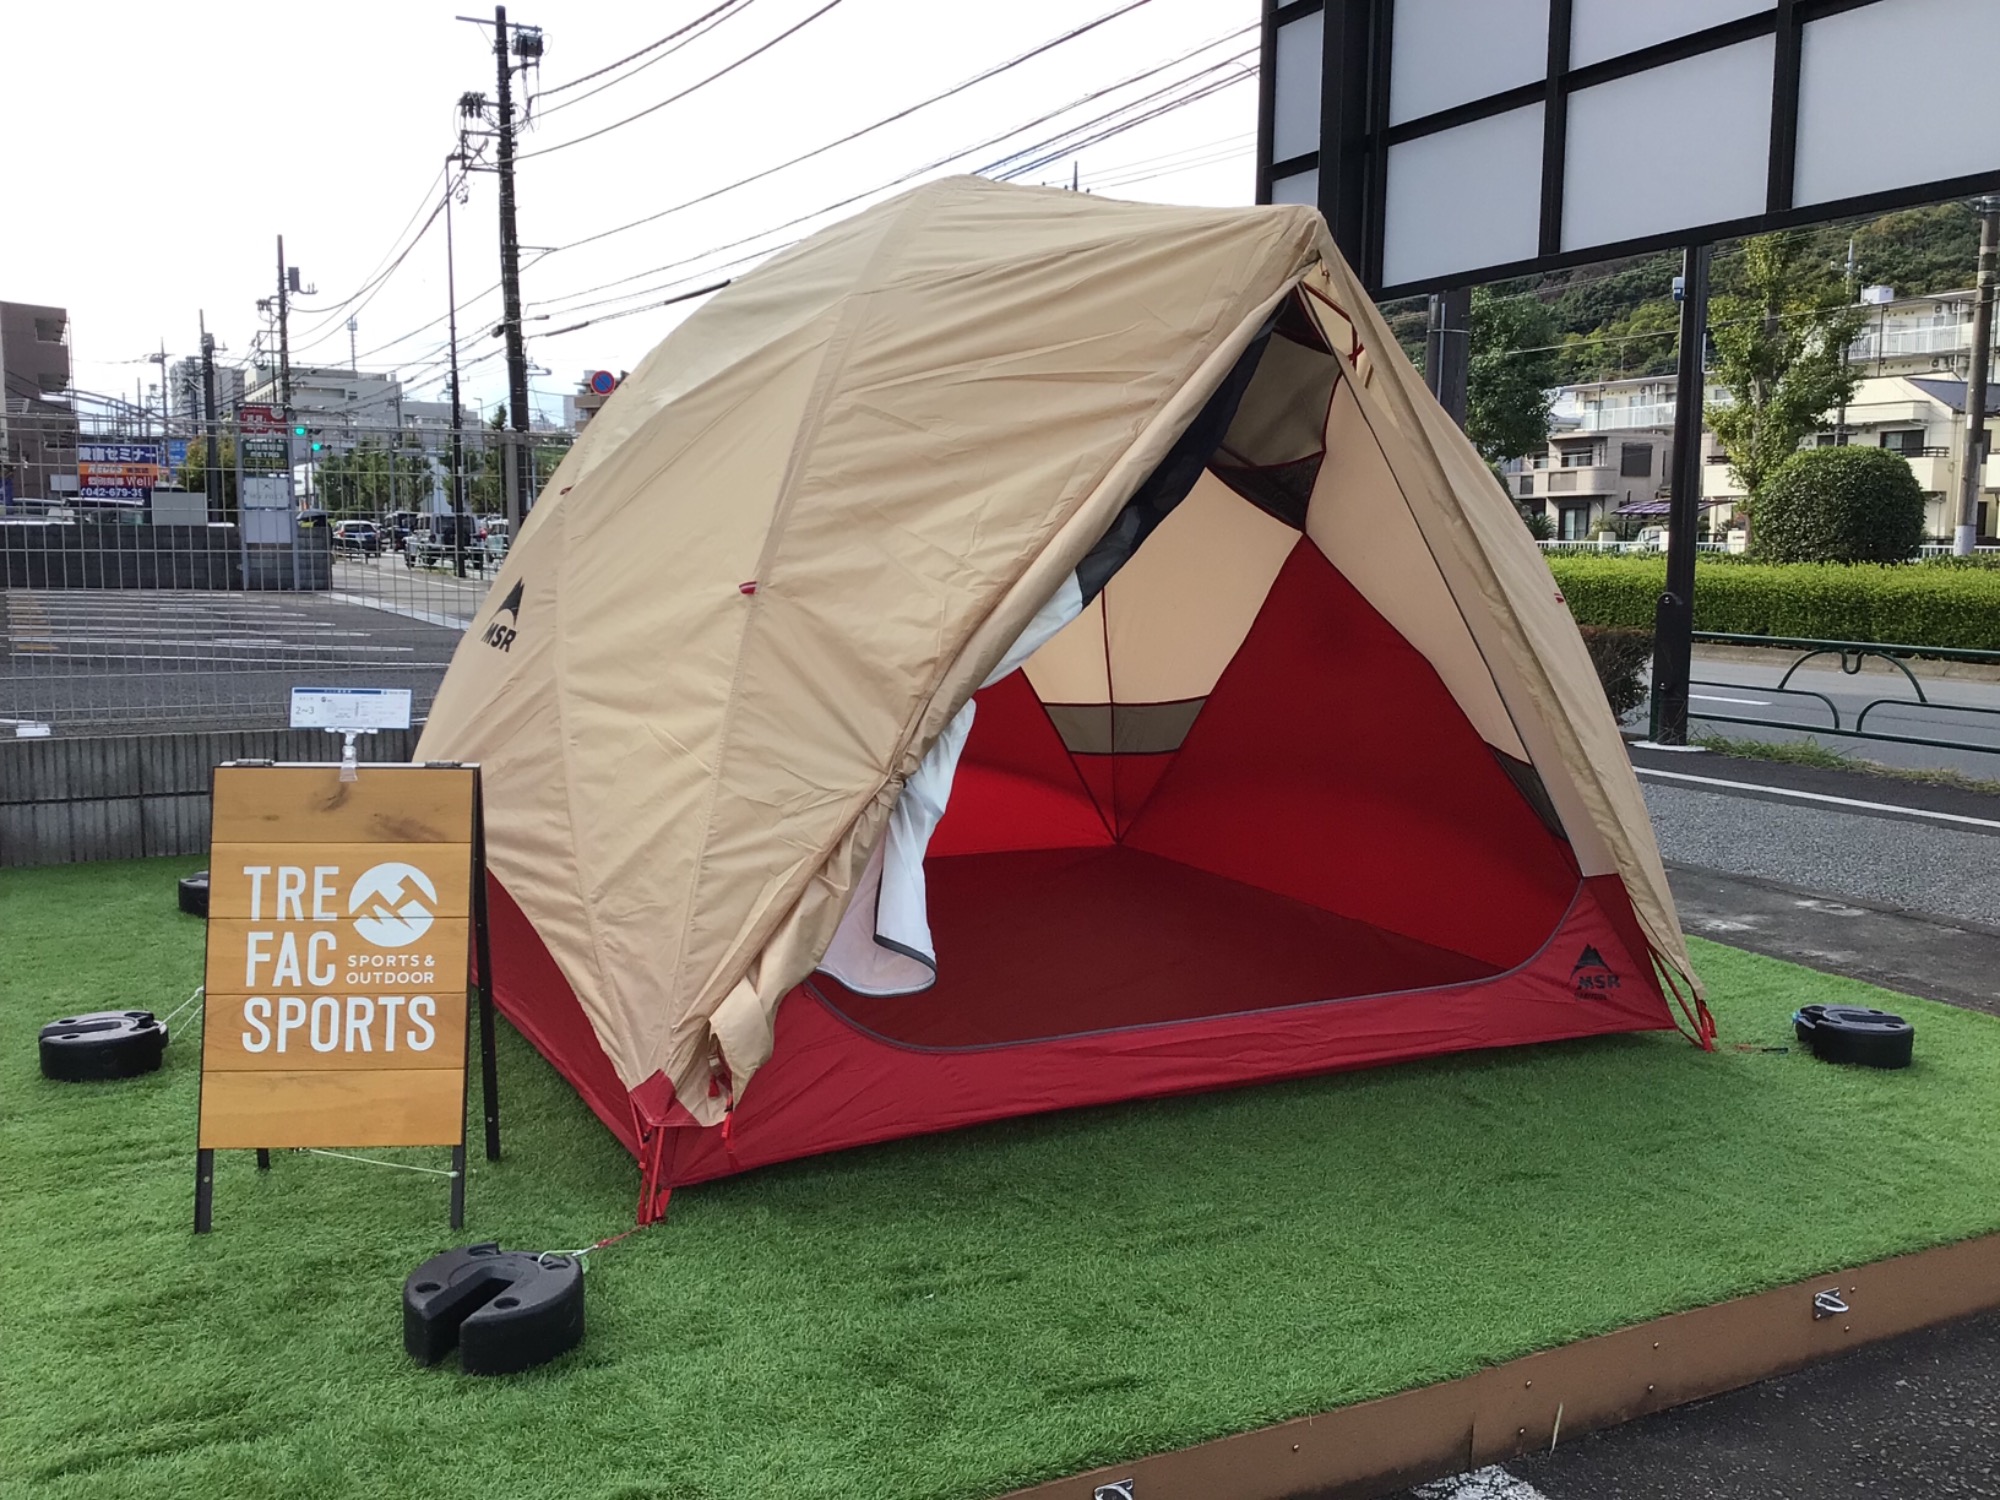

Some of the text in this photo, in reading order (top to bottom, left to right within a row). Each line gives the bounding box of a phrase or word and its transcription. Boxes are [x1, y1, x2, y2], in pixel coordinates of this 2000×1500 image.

[126, 477, 151, 486] Well
[481, 622, 517, 653] MSR
[243, 866, 339, 921] TRE
[245, 931, 337, 987] FAC
[347, 955, 435, 967] SPORTS &
[346, 972, 434, 984] OUTDOOR
[1577, 975, 1620, 990] MSR
[242, 996, 436, 1053] SPORTS
